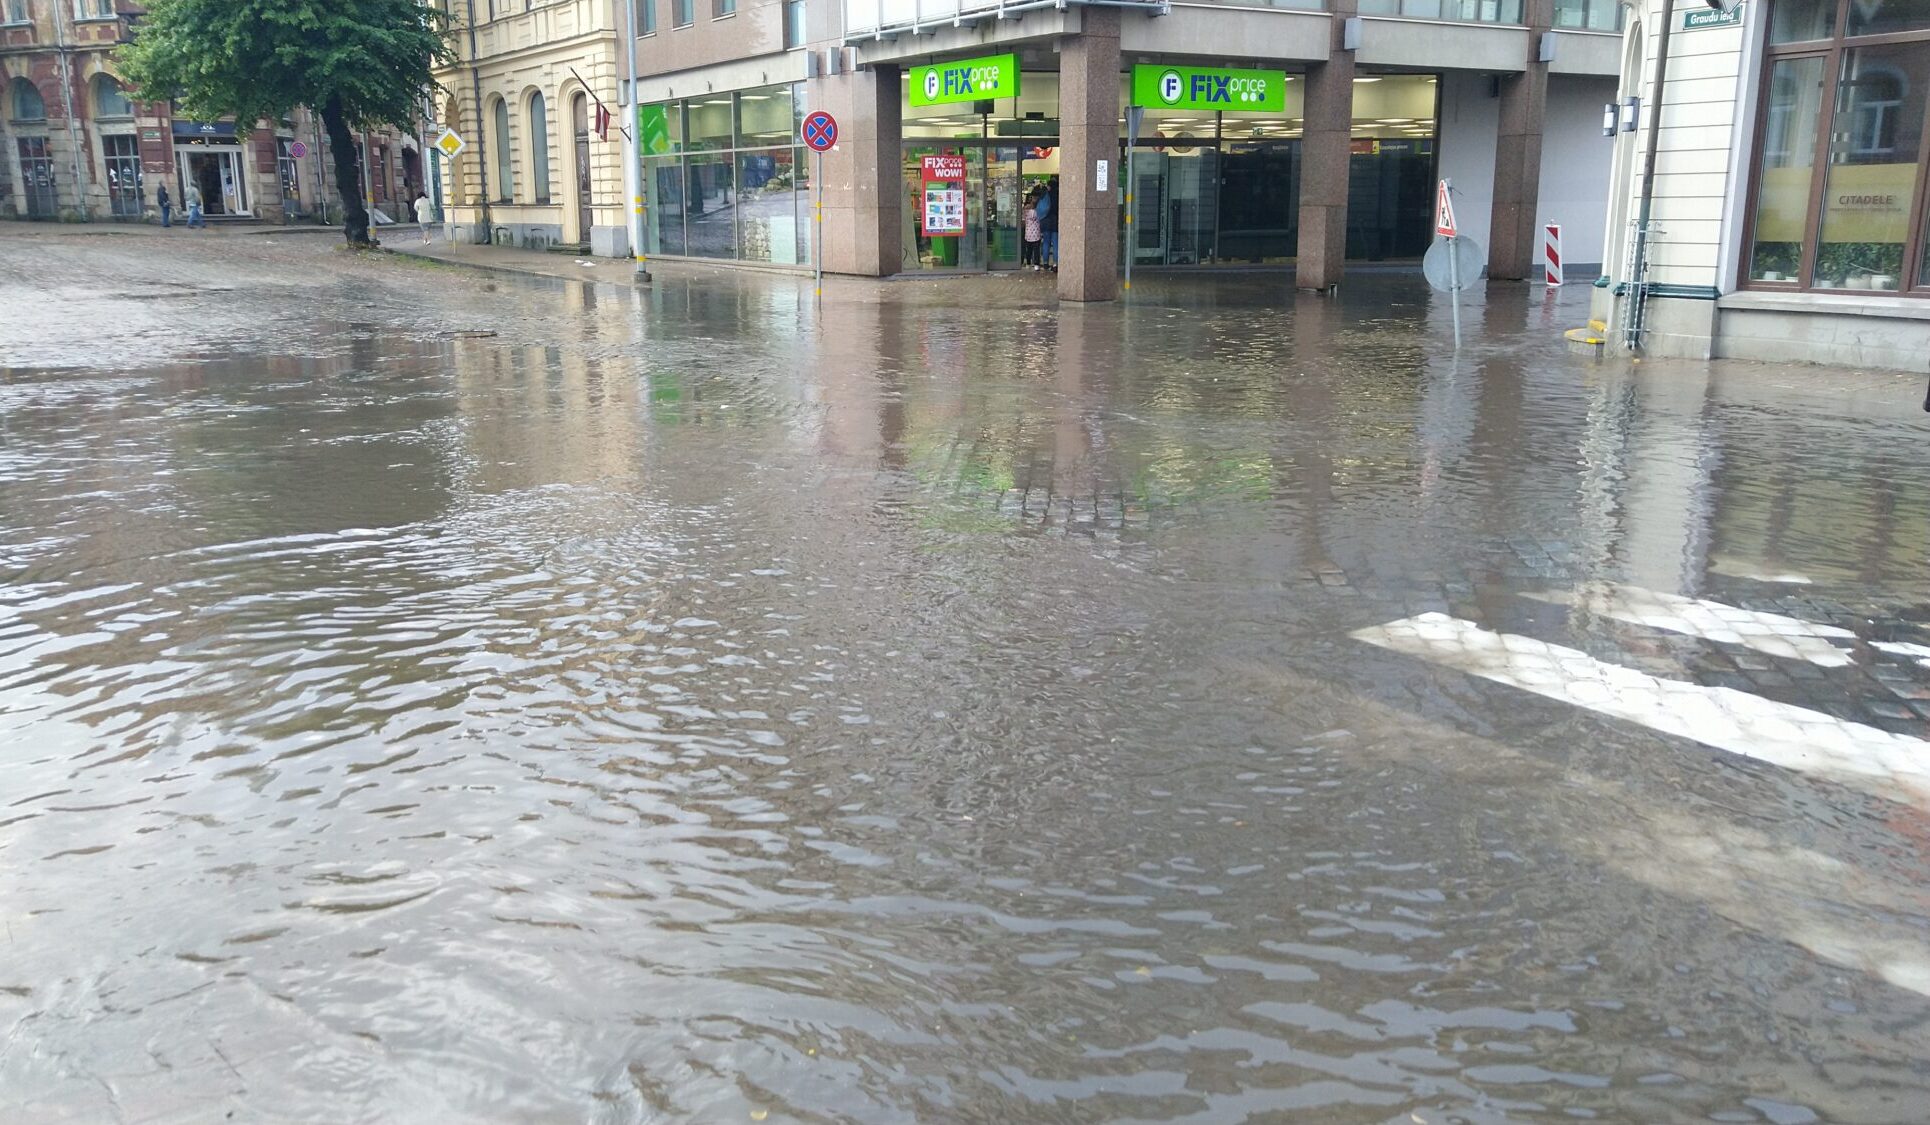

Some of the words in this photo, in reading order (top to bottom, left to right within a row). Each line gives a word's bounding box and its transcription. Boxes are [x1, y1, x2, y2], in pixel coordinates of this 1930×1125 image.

[1691, 12, 1718, 24] Graudu
[971, 66, 999, 84] price
[1230, 78, 1266, 94] price
[935, 168, 962, 178] WOW!
[1839, 195, 1894, 205] CITADELE
